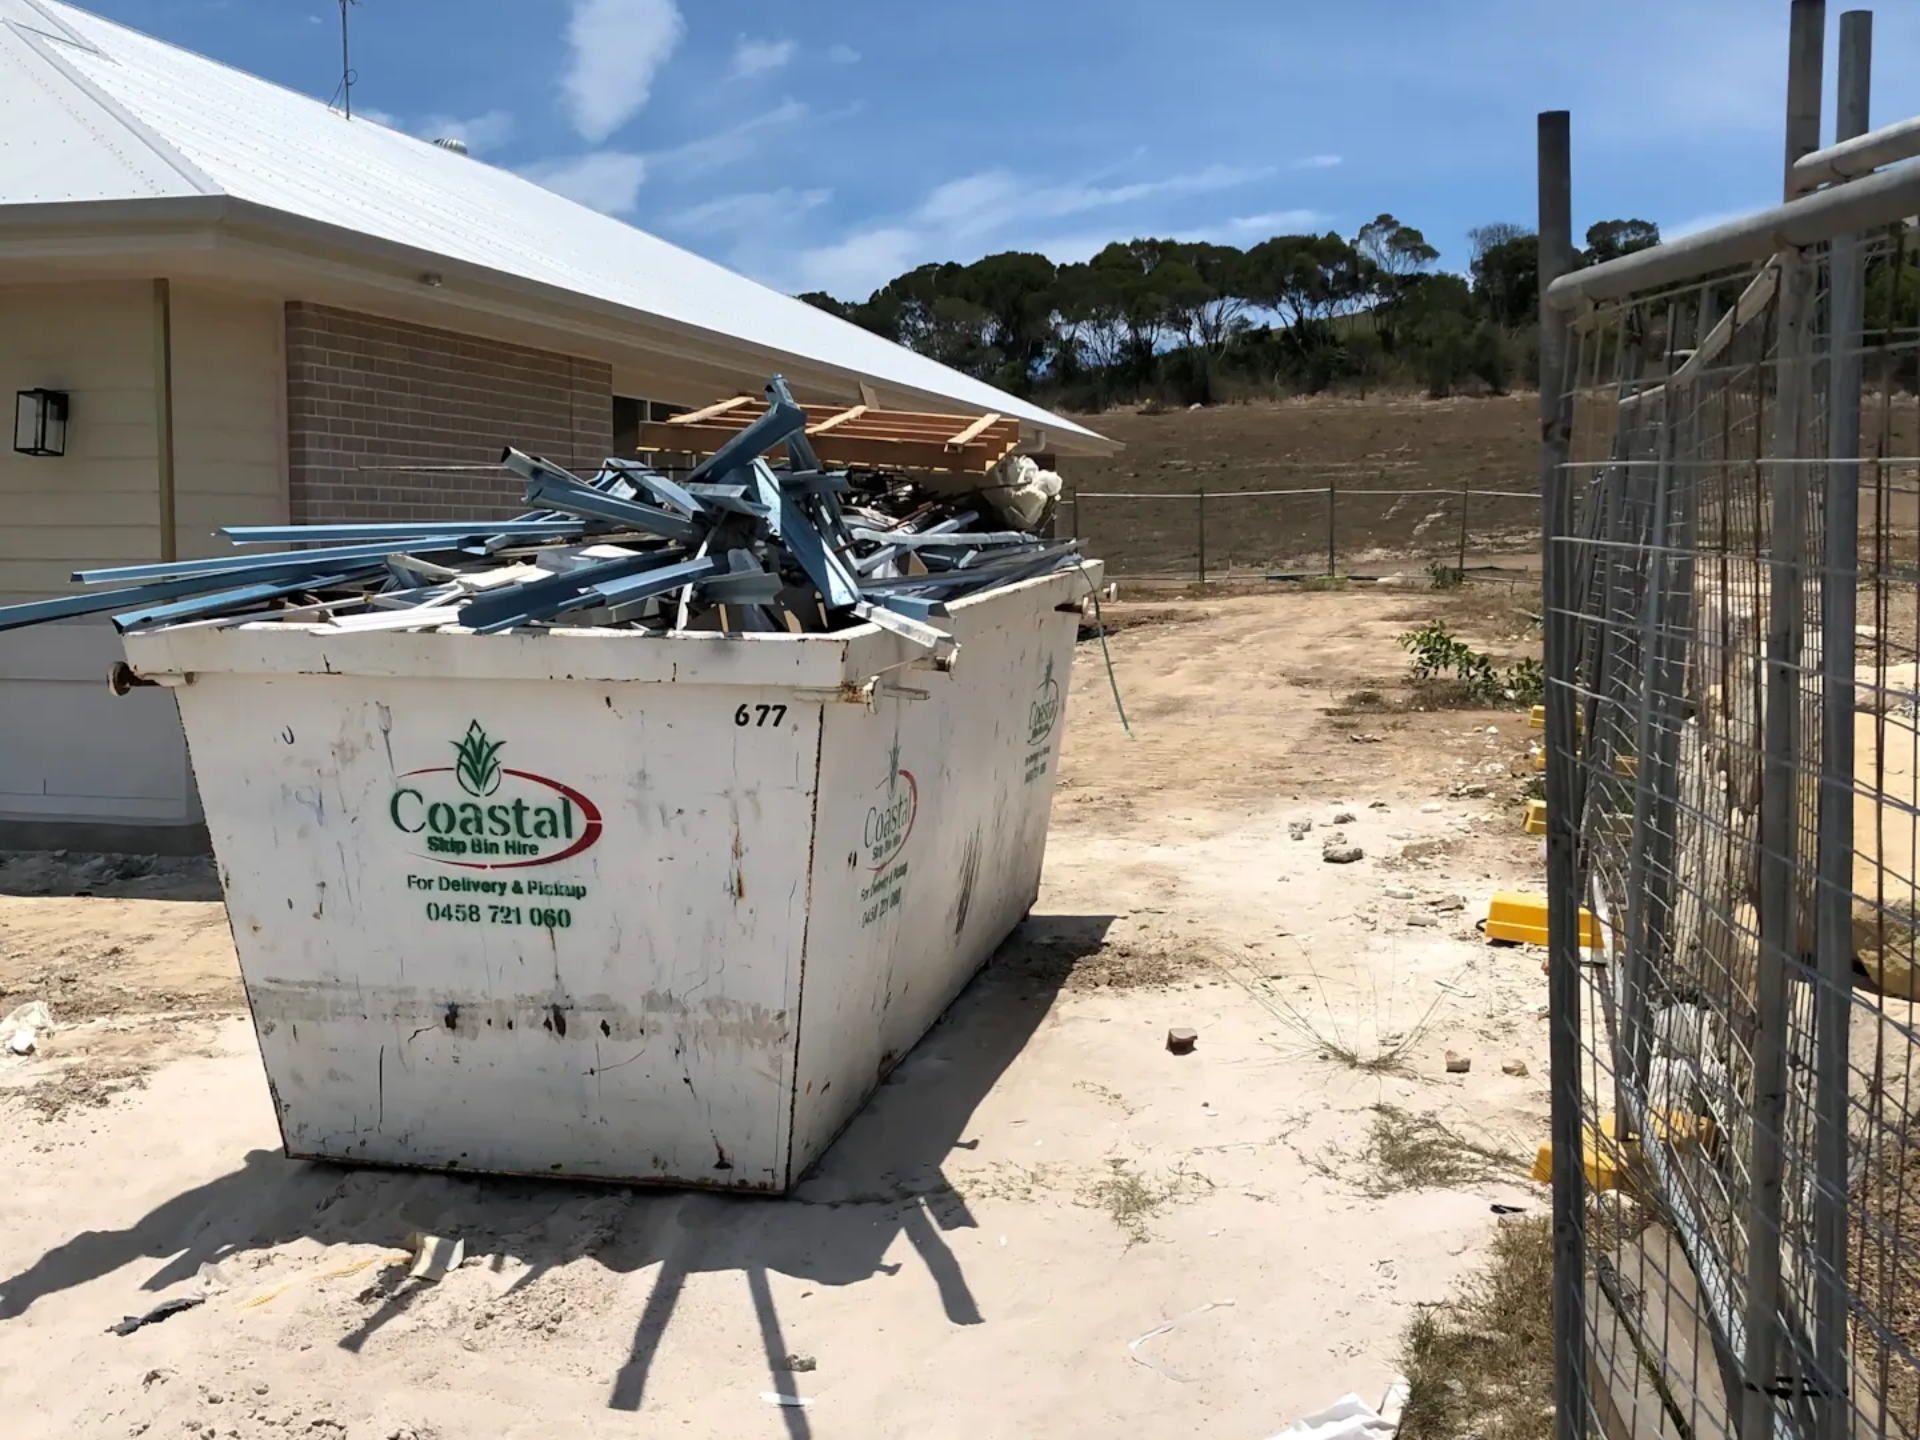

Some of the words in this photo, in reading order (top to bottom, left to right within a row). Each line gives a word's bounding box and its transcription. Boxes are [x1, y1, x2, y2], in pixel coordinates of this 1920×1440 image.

[735, 703, 788, 728] 677
[390, 788, 573, 839] Coastal
[864, 785, 912, 849] Coastal
[471, 838, 500, 855] Bin
[504, 840, 539, 856] Hire
[407, 874, 434, 891] For
[438, 876, 507, 897] Delivery
[511, 879, 524, 895] &
[527, 880, 587, 901] Pickup
[426, 902, 481, 923] 0458
[487, 904, 522, 925] 721
[528, 907, 572, 928] 060
